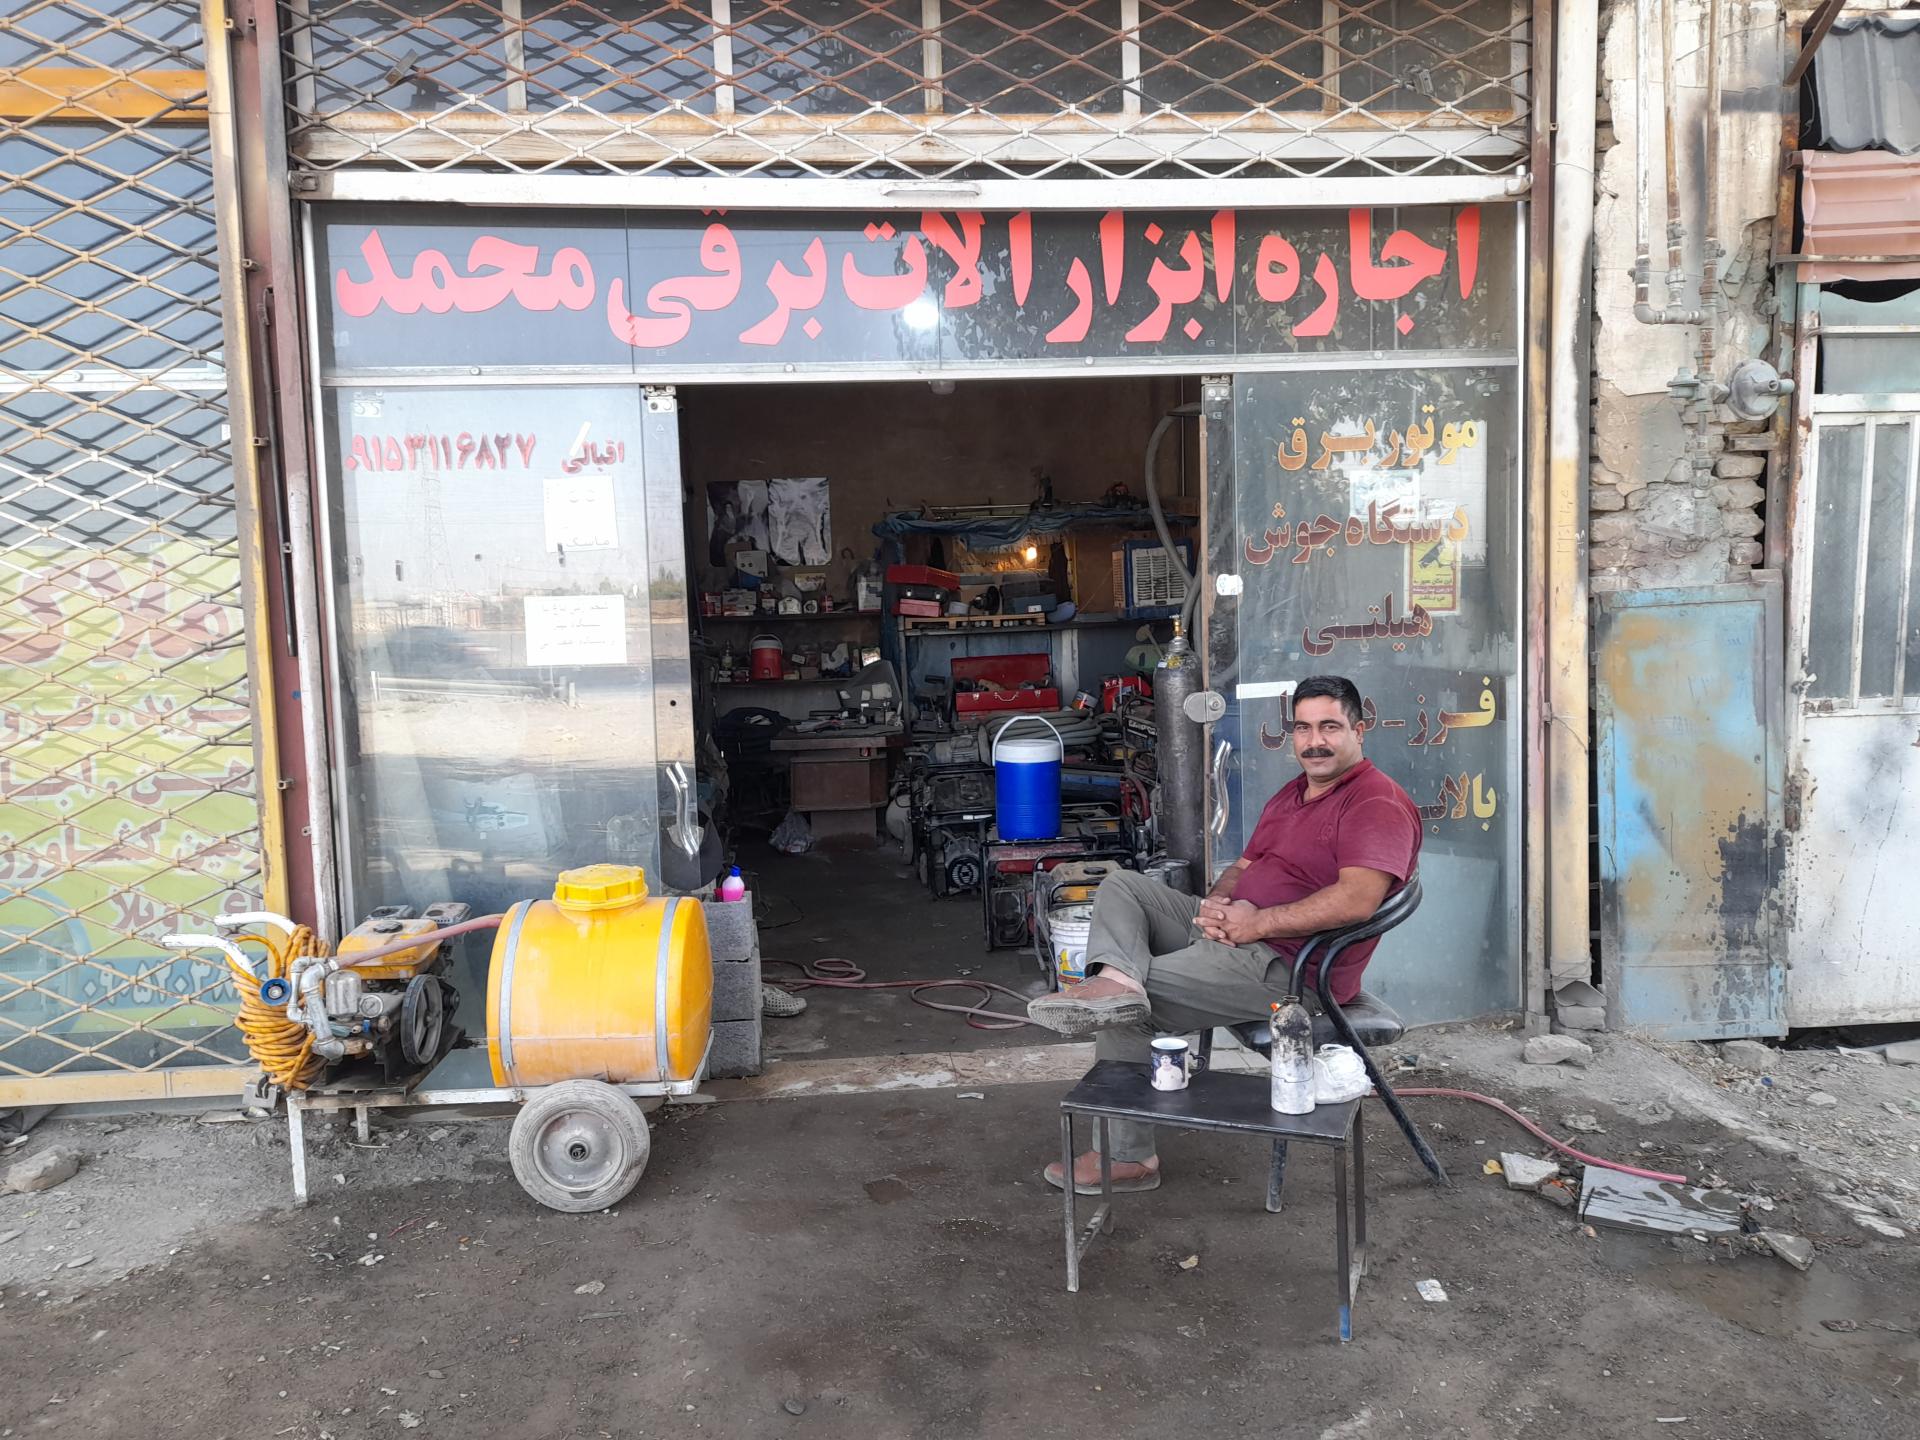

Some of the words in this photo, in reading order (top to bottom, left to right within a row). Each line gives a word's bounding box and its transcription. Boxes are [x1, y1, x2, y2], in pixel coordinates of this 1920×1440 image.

[335, 227, 597, 318] محمد
[606, 208, 828, 348] برقی
[1254, 208, 1481, 338] اجاره
[1277, 416, 1376, 471] برق
[1378, 404, 1479, 468] موتور
[1244, 502, 1343, 565] جوش
[1345, 499, 1470, 546] دستگاه
[1302, 591, 1433, 656] هیلتی
[1414, 771, 1497, 833] بالاب
